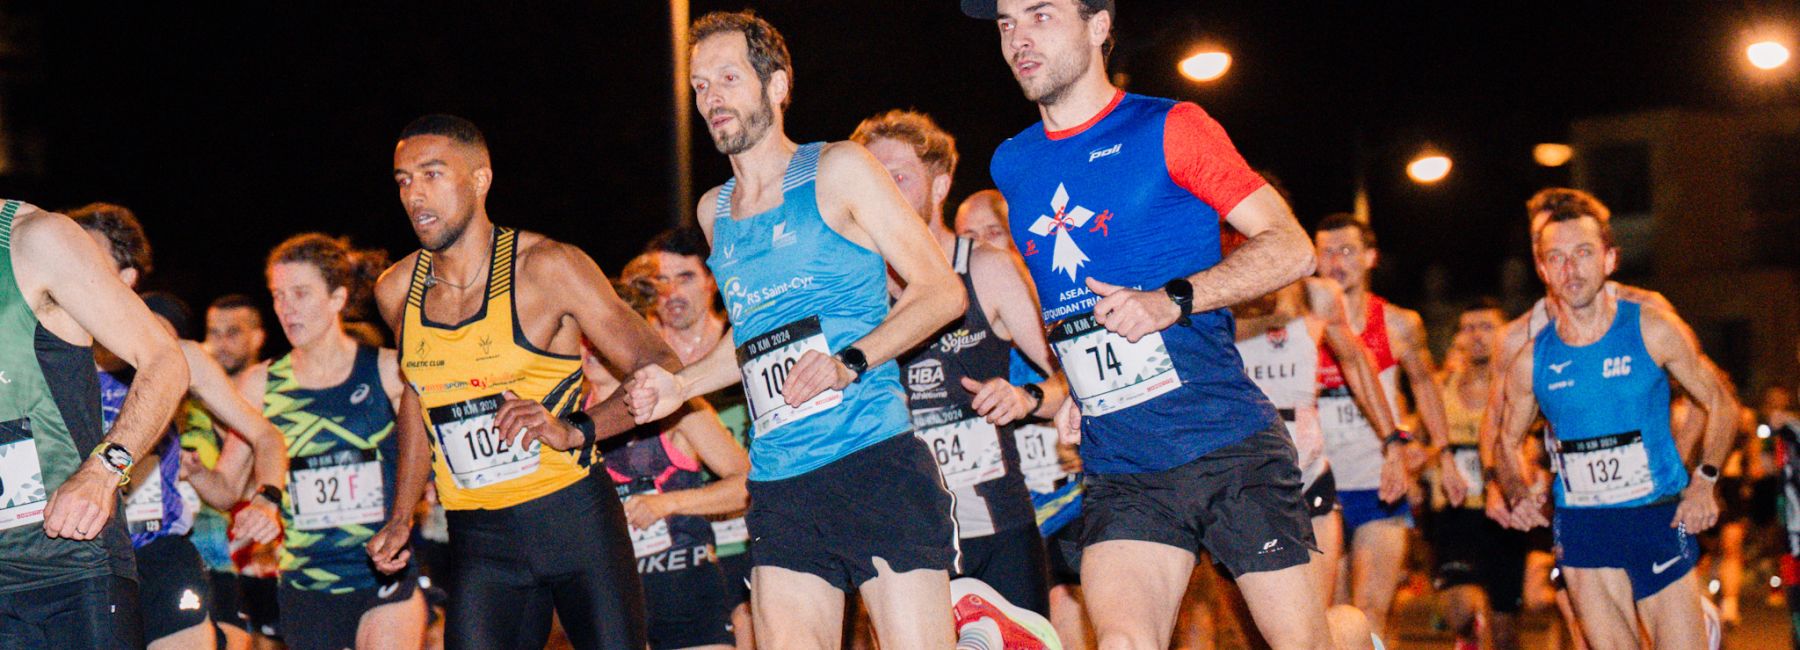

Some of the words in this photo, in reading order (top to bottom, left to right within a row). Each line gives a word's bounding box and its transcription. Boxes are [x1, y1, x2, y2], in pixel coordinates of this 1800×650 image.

[1089, 144, 1122, 162] poli
[746, 290, 762, 305] RS
[762, 275, 815, 300] Saint-Cyr
[1081, 295, 1103, 310] TRIA
[1064, 323, 1073, 336] 10
[1074, 318, 1091, 333] KM
[748, 344, 757, 356] 10
[758, 337, 773, 352] KM
[771, 329, 791, 345] 2024
[940, 329, 986, 354] Sojasun
[429, 359, 445, 367] CLUB
[1085, 342, 1122, 381] 74
[908, 365, 945, 385] HBA
[452, 407, 463, 417] 10
[463, 402, 479, 415] KM
[480, 399, 498, 413] 2024
[463, 426, 511, 461] 102
[933, 434, 965, 465] 64
[1023, 434, 1048, 460] 51
[1586, 457, 1623, 484] 132
[314, 477, 340, 504] 32
[348, 474, 358, 500] F
[637, 548, 688, 574] IKE
[693, 545, 709, 566] P
